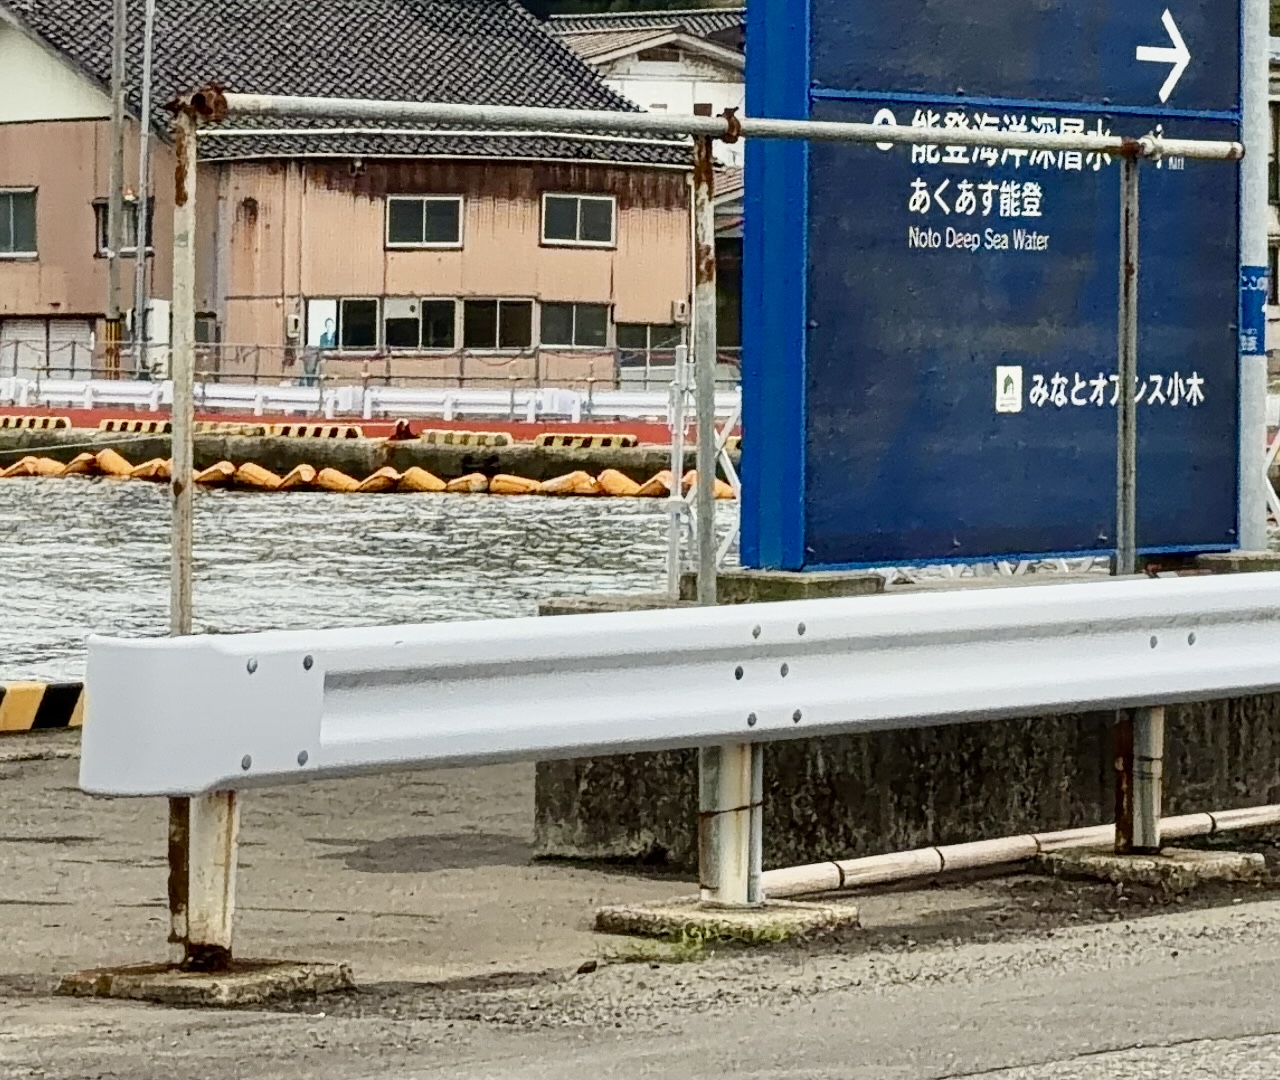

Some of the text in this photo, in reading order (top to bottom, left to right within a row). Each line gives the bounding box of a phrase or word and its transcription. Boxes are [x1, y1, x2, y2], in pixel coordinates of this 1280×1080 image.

[908, 177, 1043, 218] あくあす能登
[908, 226, 1050, 253] Noto Deep Sea Water
